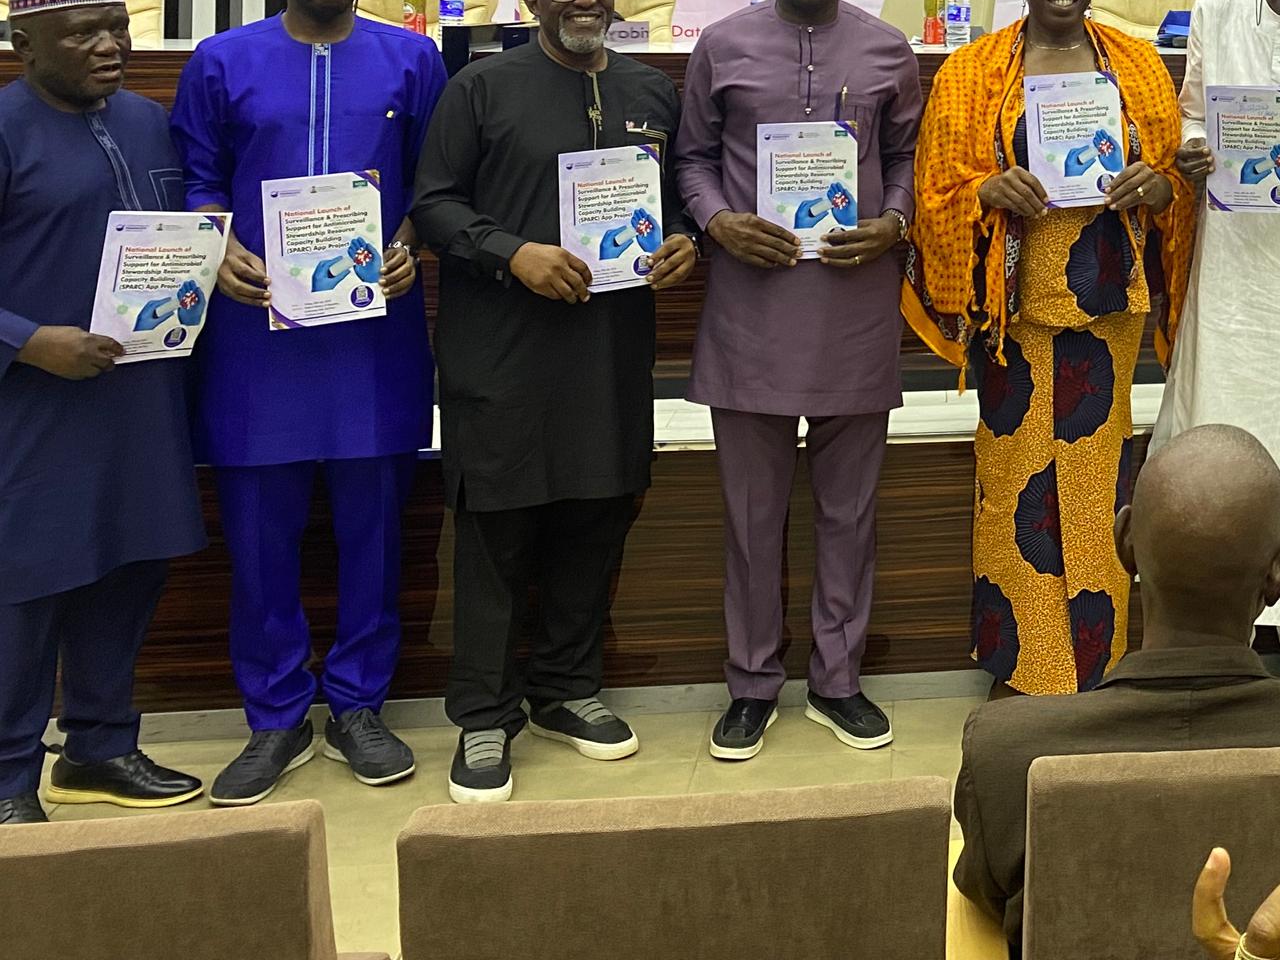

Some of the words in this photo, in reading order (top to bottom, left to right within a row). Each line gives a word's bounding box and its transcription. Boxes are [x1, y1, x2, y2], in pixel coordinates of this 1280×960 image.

[672, 25, 701, 38] Dat
[578, 180, 604, 188] National
[605, 178, 627, 186] Launch
[578, 187, 611, 195] Surveillance
[619, 182, 649, 190] Prescribing
[284, 209, 315, 218] National
[318, 207, 342, 215] Launch
[285, 215, 324, 224] Surveillance
[333, 211, 368, 219] Prescribing
[286, 224, 311, 232] Support
[324, 218, 366, 228] Antimicrobial
[286, 230, 326, 239] Stewardship
[287, 239, 314, 247] Capacity
[316, 236, 342, 244] Building
[287, 246, 312, 255] (SPARC)
[314, 244, 326, 252] App
[328, 242, 350, 250] Project
